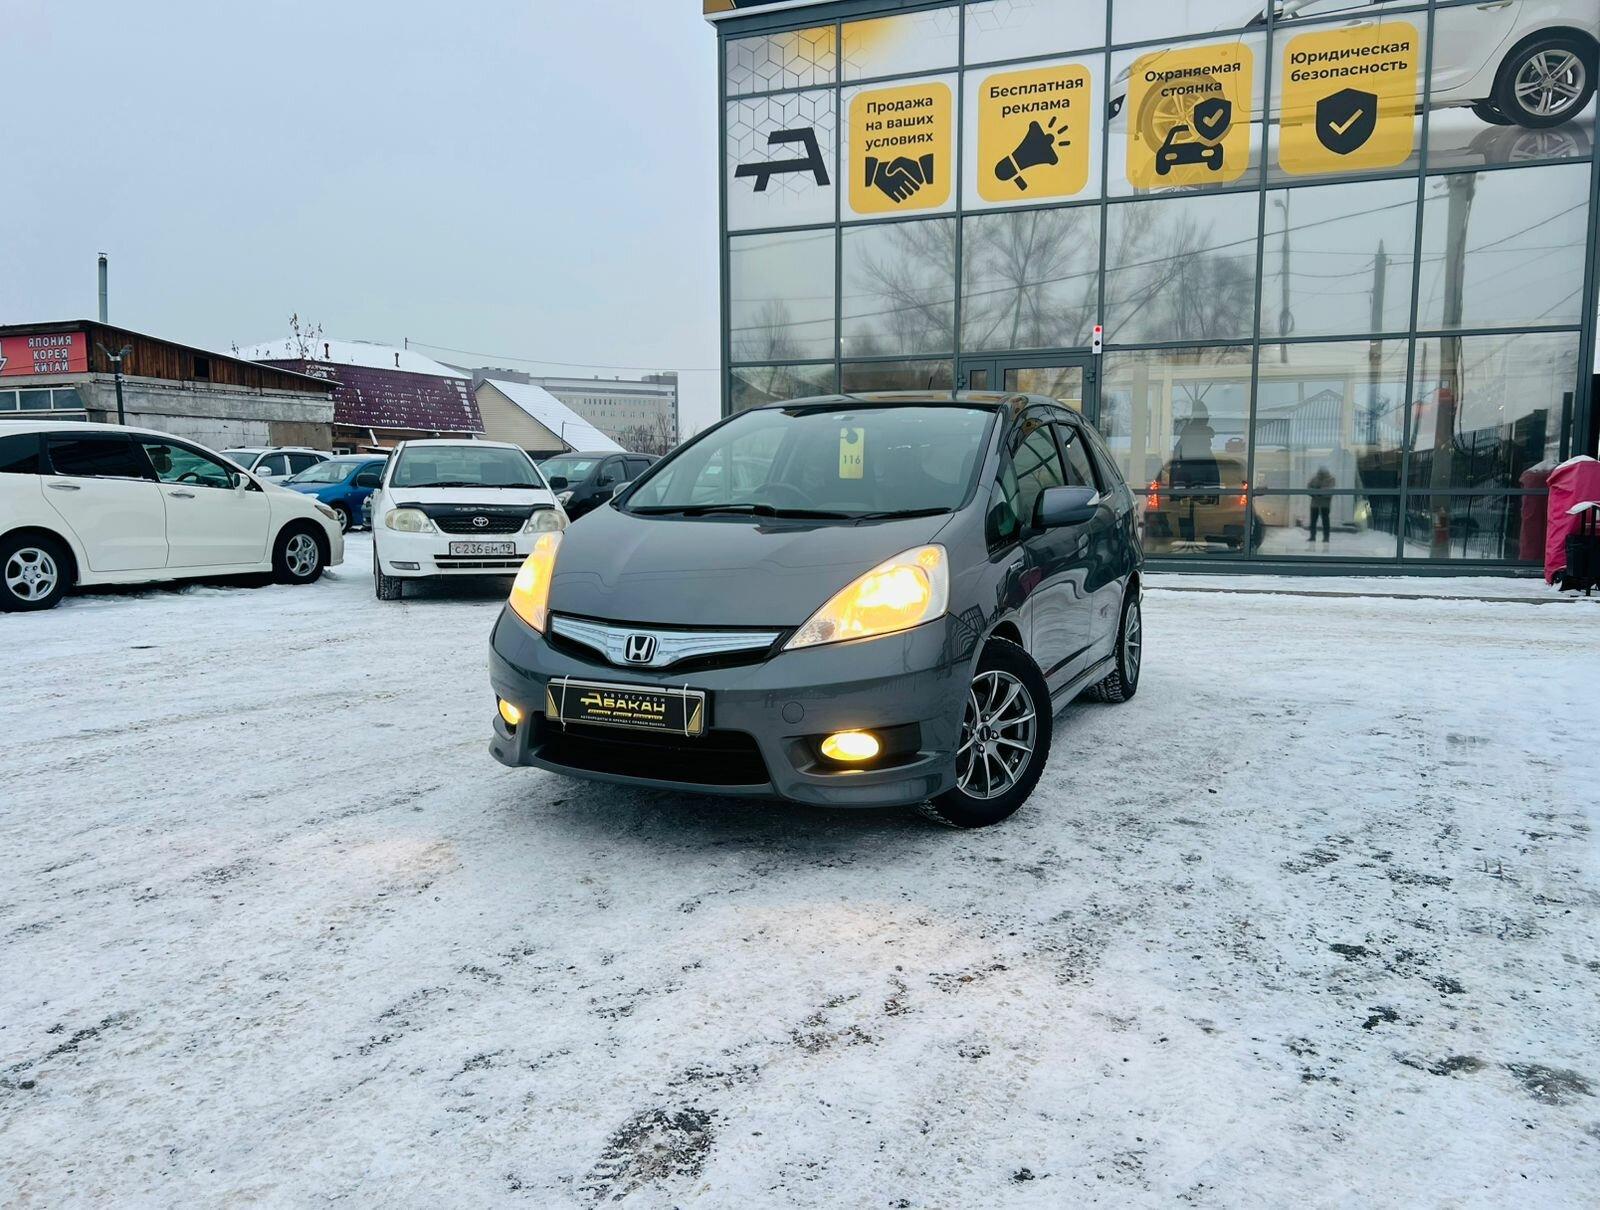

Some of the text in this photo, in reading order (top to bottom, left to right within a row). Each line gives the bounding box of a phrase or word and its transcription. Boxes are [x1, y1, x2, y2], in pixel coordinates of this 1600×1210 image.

[1291, 41, 1410, 65] Юридическая
[1145, 62, 1241, 82] Охраняемая
[1291, 60, 1408, 82] безопасность
[990, 78, 1084, 99] Бесплатная
[1161, 82, 1222, 97] стоянка
[867, 97, 933, 115] Продажа
[1002, 98, 1070, 118] реклама
[866, 115, 934, 131] на ваших
[865, 133, 934, 151] условиях
[28, 335, 72, 348] ЯПОНИЯ
[33, 348, 68, 360] КОРЕЯ
[34, 360, 69, 373] КИТАЙ
[844, 455, 861, 465] 116
[603, 692, 666, 702] АВТОСАЛОН
